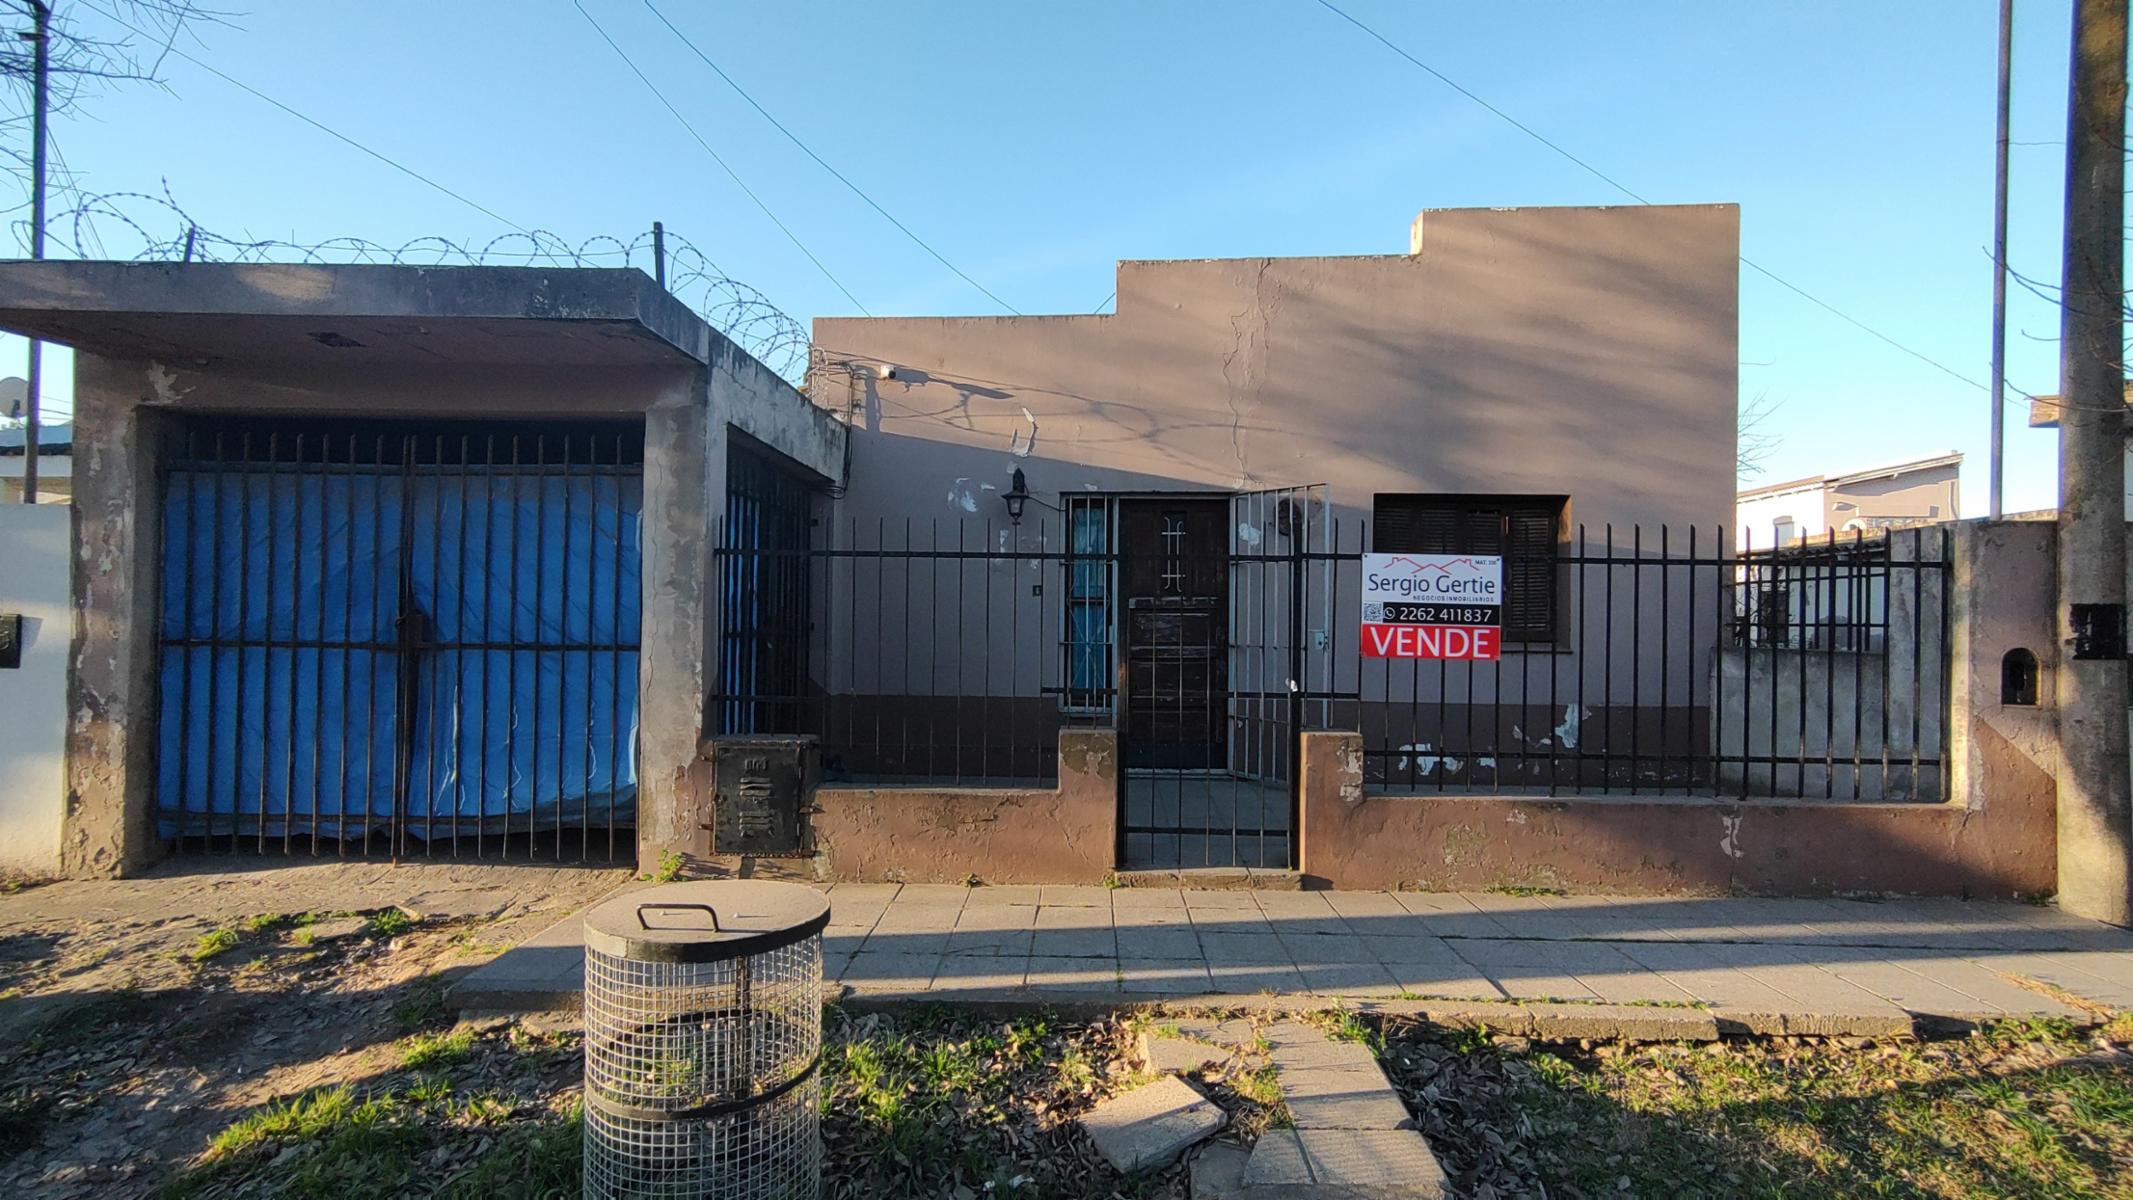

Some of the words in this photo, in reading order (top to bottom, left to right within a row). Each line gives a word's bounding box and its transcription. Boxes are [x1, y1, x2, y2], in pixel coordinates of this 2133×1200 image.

[1368, 573, 1430, 596] Sergio
[1436, 575, 1495, 594] Gertie
[1400, 607, 1435, 621] 2262
[1440, 608, 1492, 623] 411837
[1370, 626, 1491, 658] VENDE
